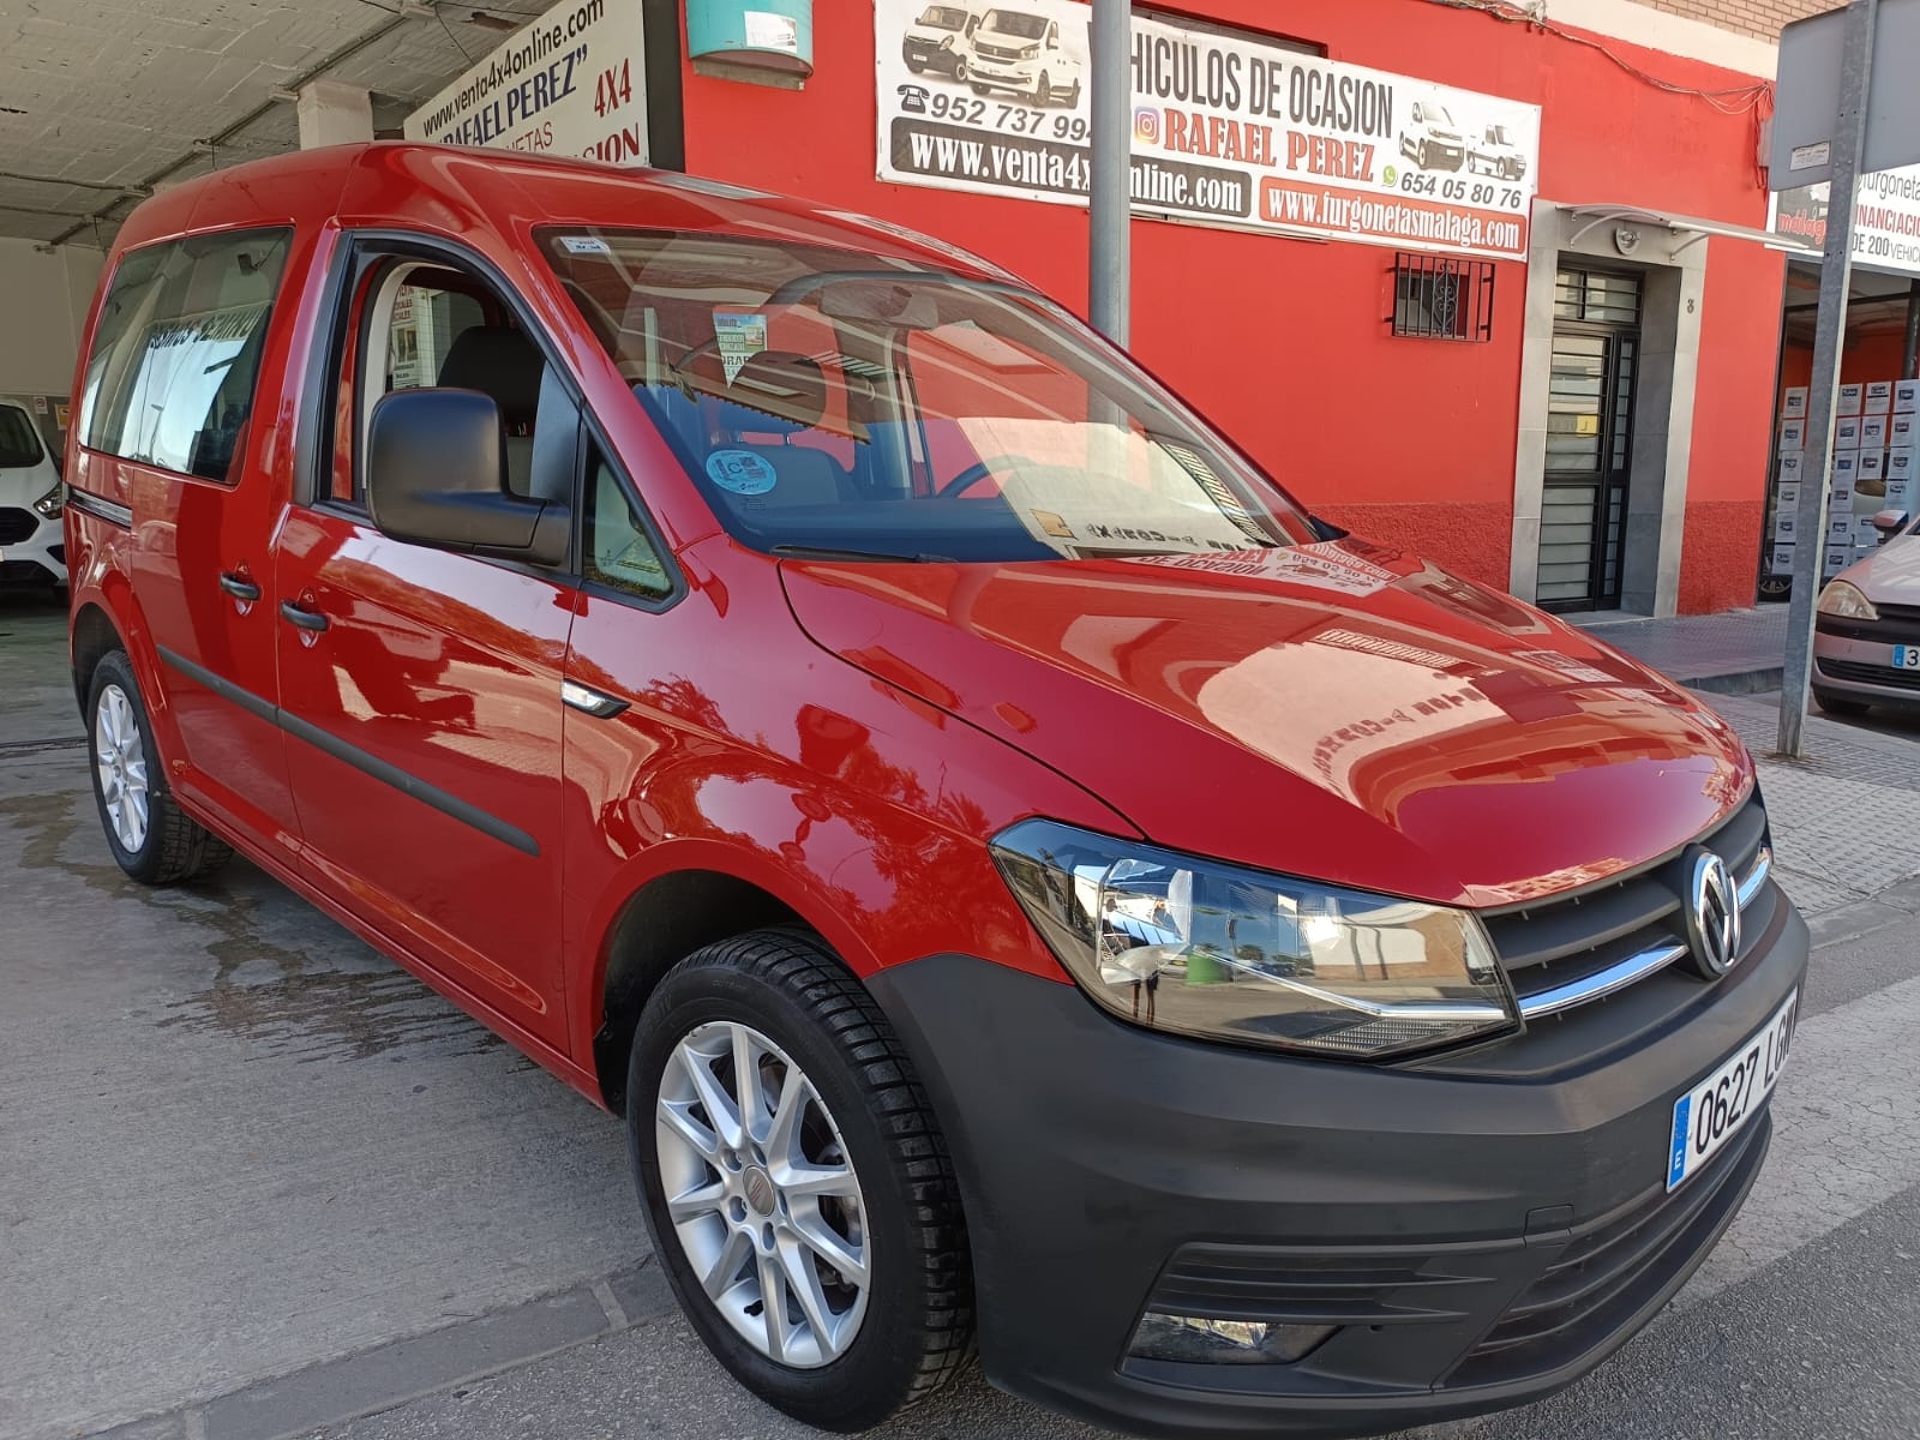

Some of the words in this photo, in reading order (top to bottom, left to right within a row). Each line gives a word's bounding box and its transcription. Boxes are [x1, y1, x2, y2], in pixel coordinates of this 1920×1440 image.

[423, 0, 604, 138] www.venta4x4online.com
[594, 57, 632, 118] 4X4
[1250, 57, 1283, 120] DE
[1288, 64, 1394, 139] OCASION
[930, 92, 987, 126] 952
[996, 104, 1046, 135] 737
[1052, 115, 1092, 142] 99
[1163, 107, 1277, 168] RAFAEL
[1286, 129, 1376, 183] PEREZ
[1267, 186, 1520, 250] www.furgonetasmalaga.com
[1400, 172, 1436, 196] 654
[1441, 180, 1466, 201] 05
[1470, 183, 1494, 206] 80
[1500, 187, 1522, 209] 76
[1867, 234, 1890, 257] 200
[1906, 649, 1919, 667] 3
[1695, 1045, 1760, 1156] 0627
